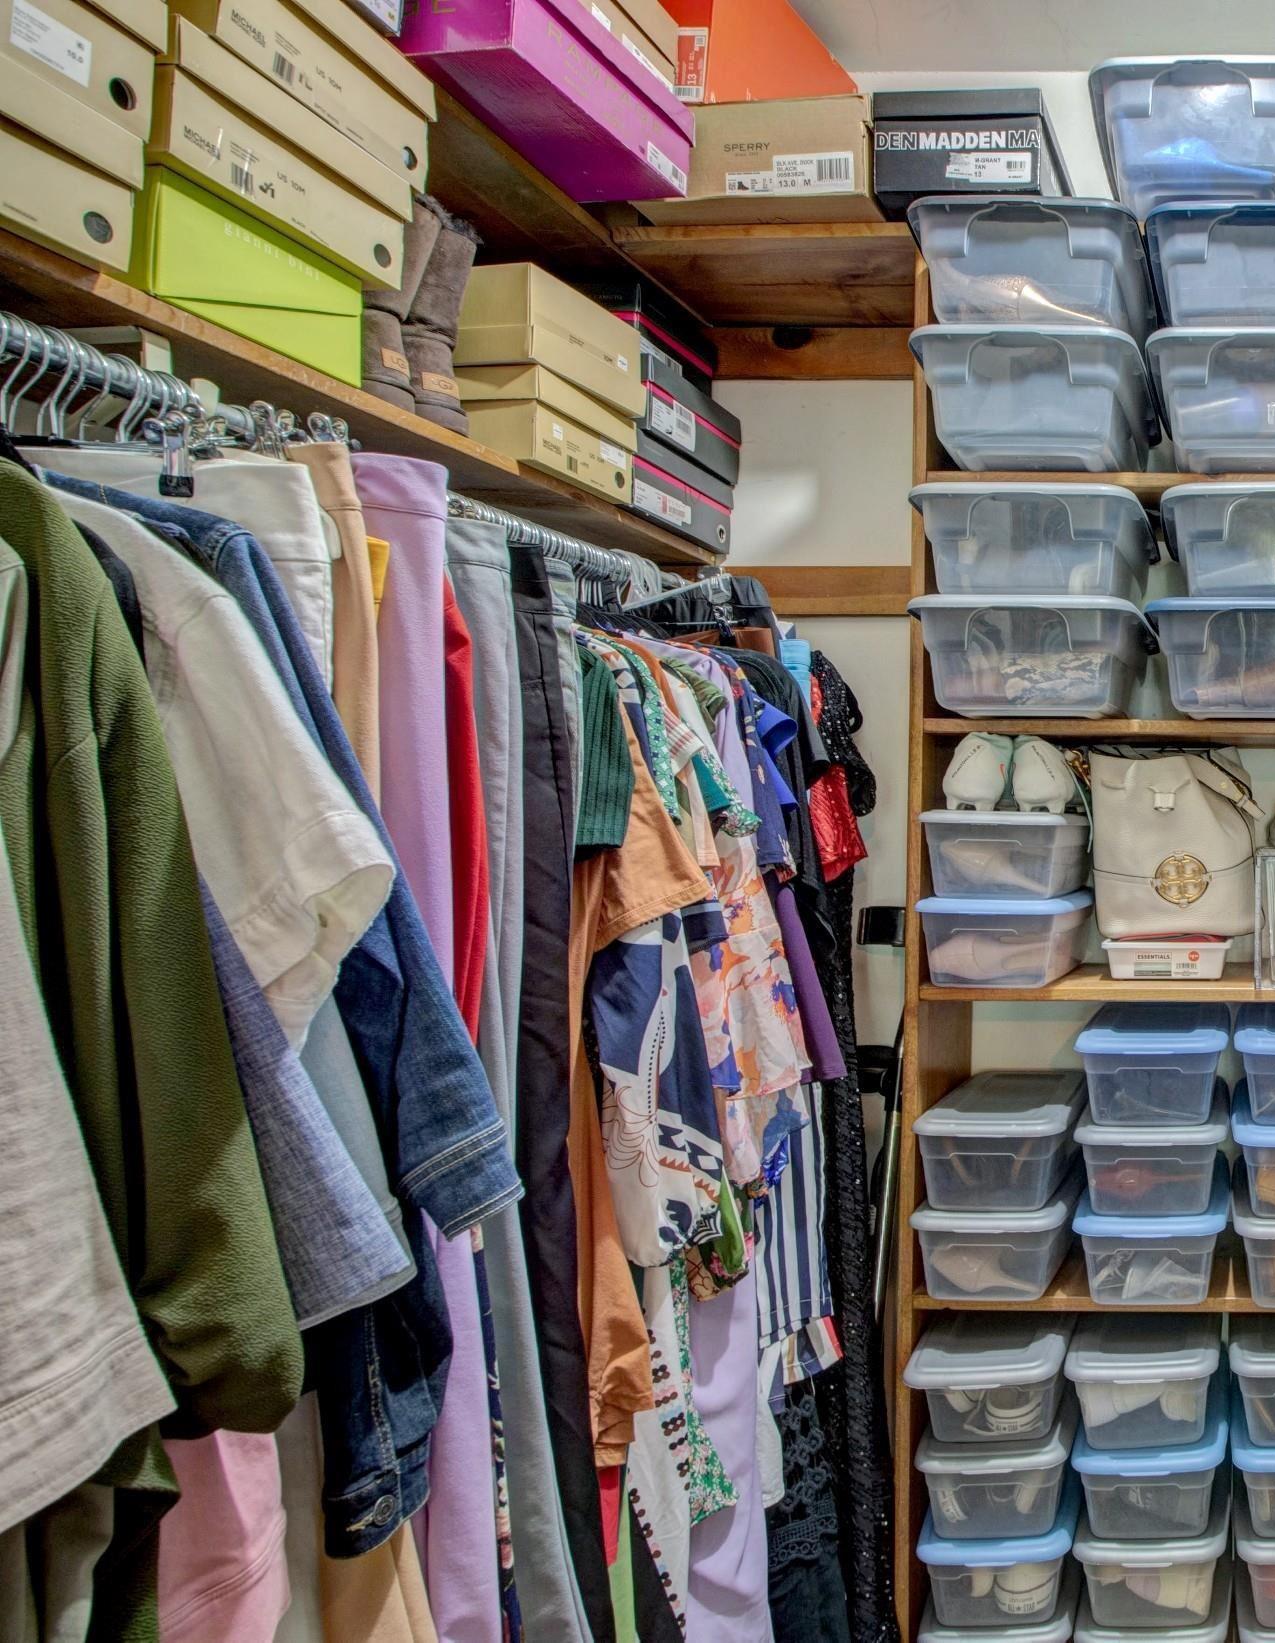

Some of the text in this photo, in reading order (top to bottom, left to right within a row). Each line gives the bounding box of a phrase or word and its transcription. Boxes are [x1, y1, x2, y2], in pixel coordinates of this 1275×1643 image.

[687, 73, 697, 86] 13
[875, 131, 917, 150] DEN
[919, 130, 1007, 150] MADDEN
[723, 142, 771, 153] SPERRY
[779, 179, 796, 188] 13.0
[803, 178, 812, 187] M
